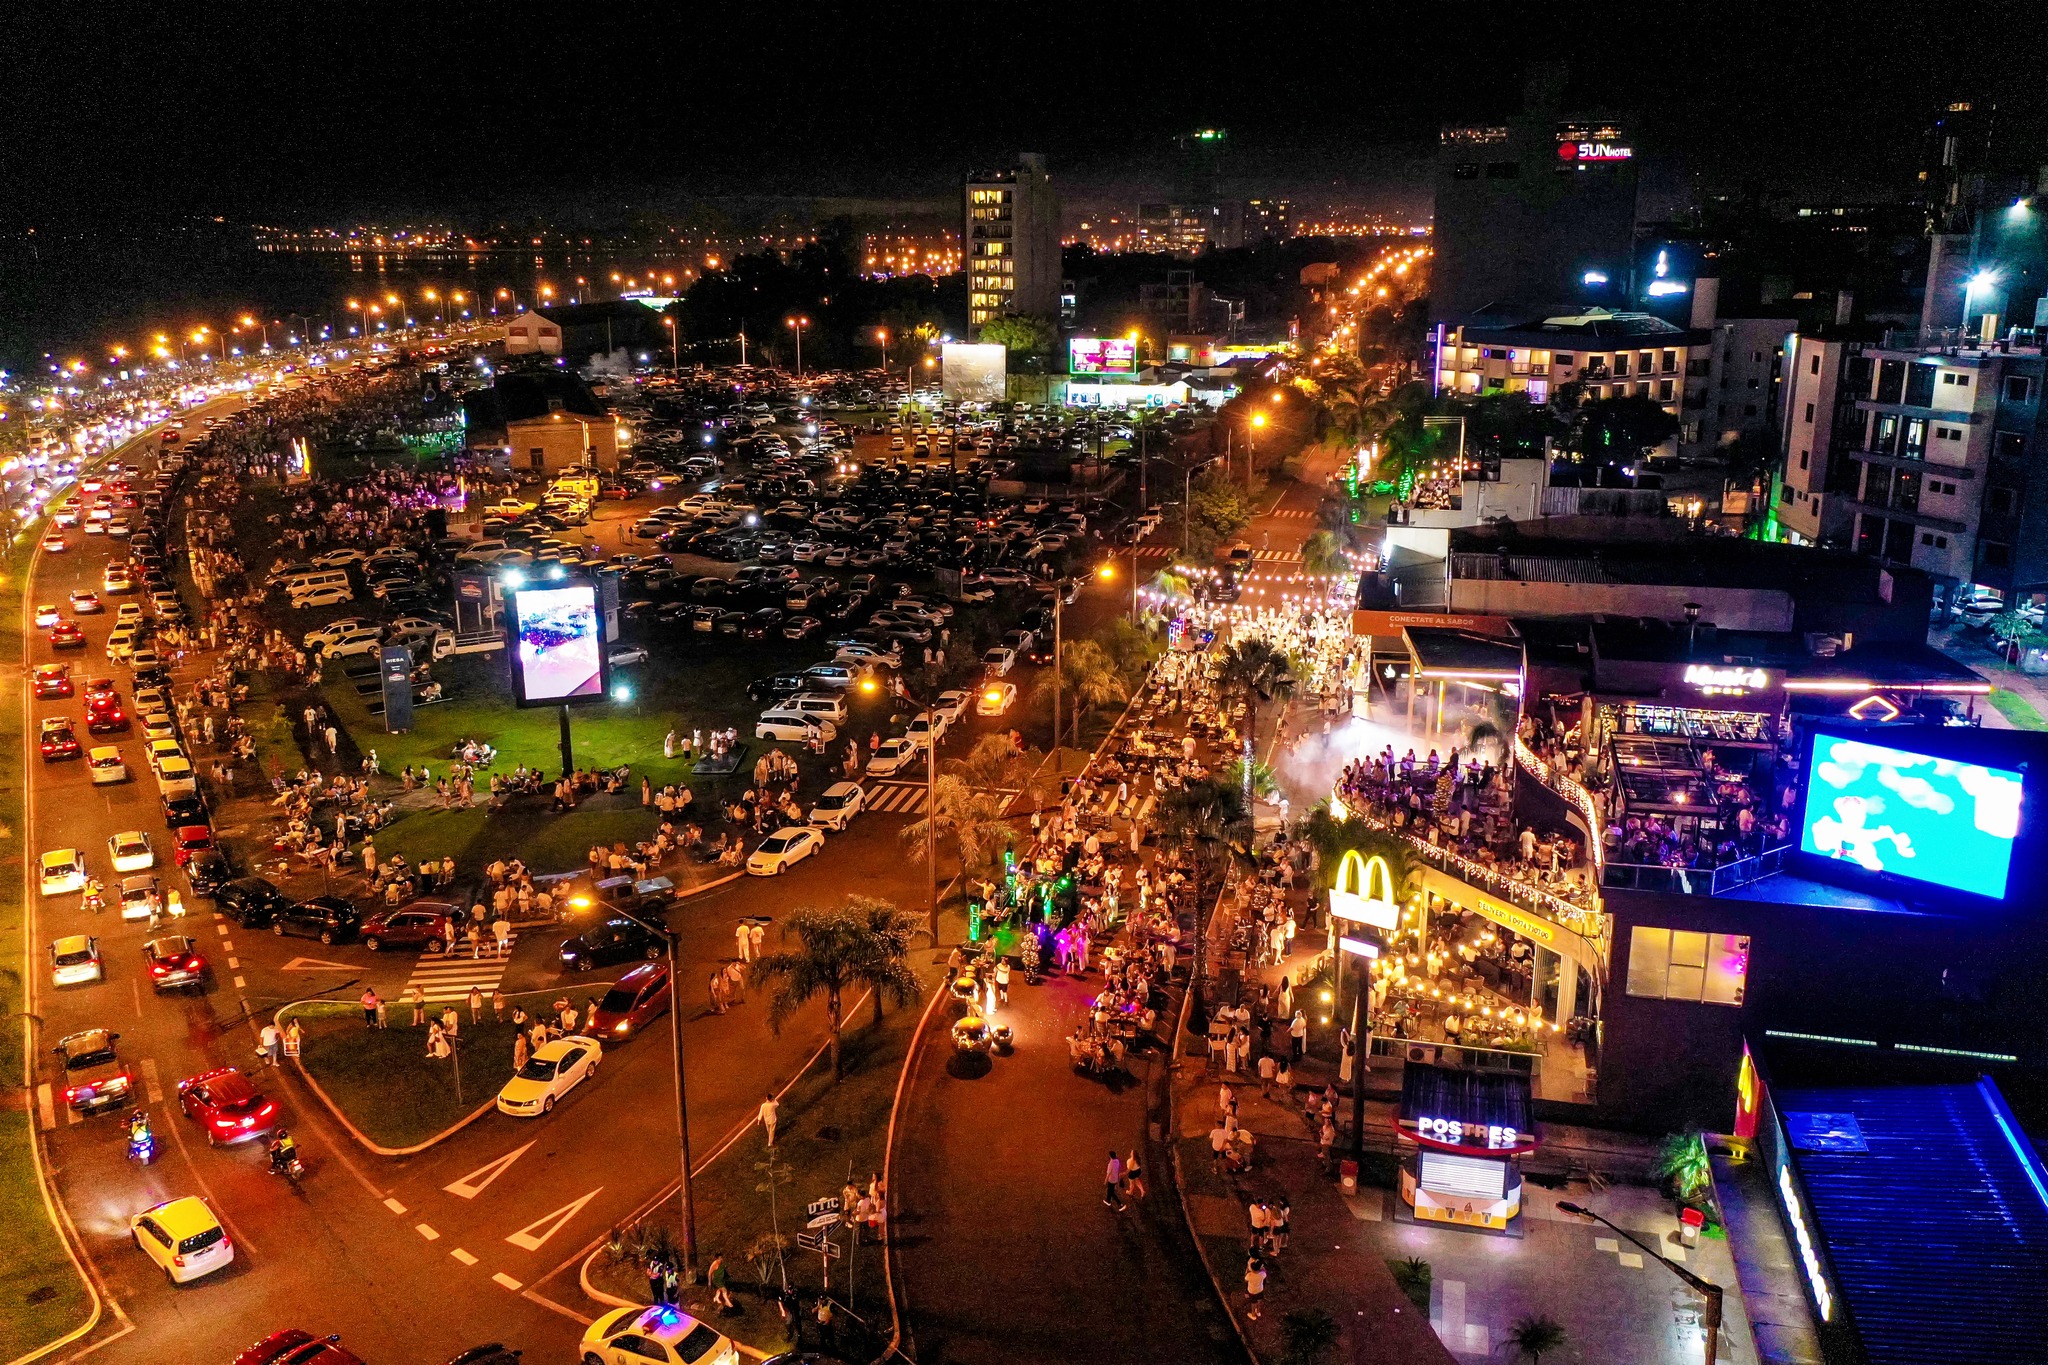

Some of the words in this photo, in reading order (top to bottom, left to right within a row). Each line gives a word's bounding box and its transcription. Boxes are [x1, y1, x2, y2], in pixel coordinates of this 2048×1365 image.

[1578, 143, 1610, 157] SUN
[1609, 148, 1632, 157] HOTEL
[1389, 615, 1434, 624] CONECTATE
[1447, 618, 1475, 626] SABOR
[1477, 901, 1508, 920] DELIVERY
[1418, 1116, 1517, 1143] POSTRES
[808, 1197, 839, 1215] UTIC
